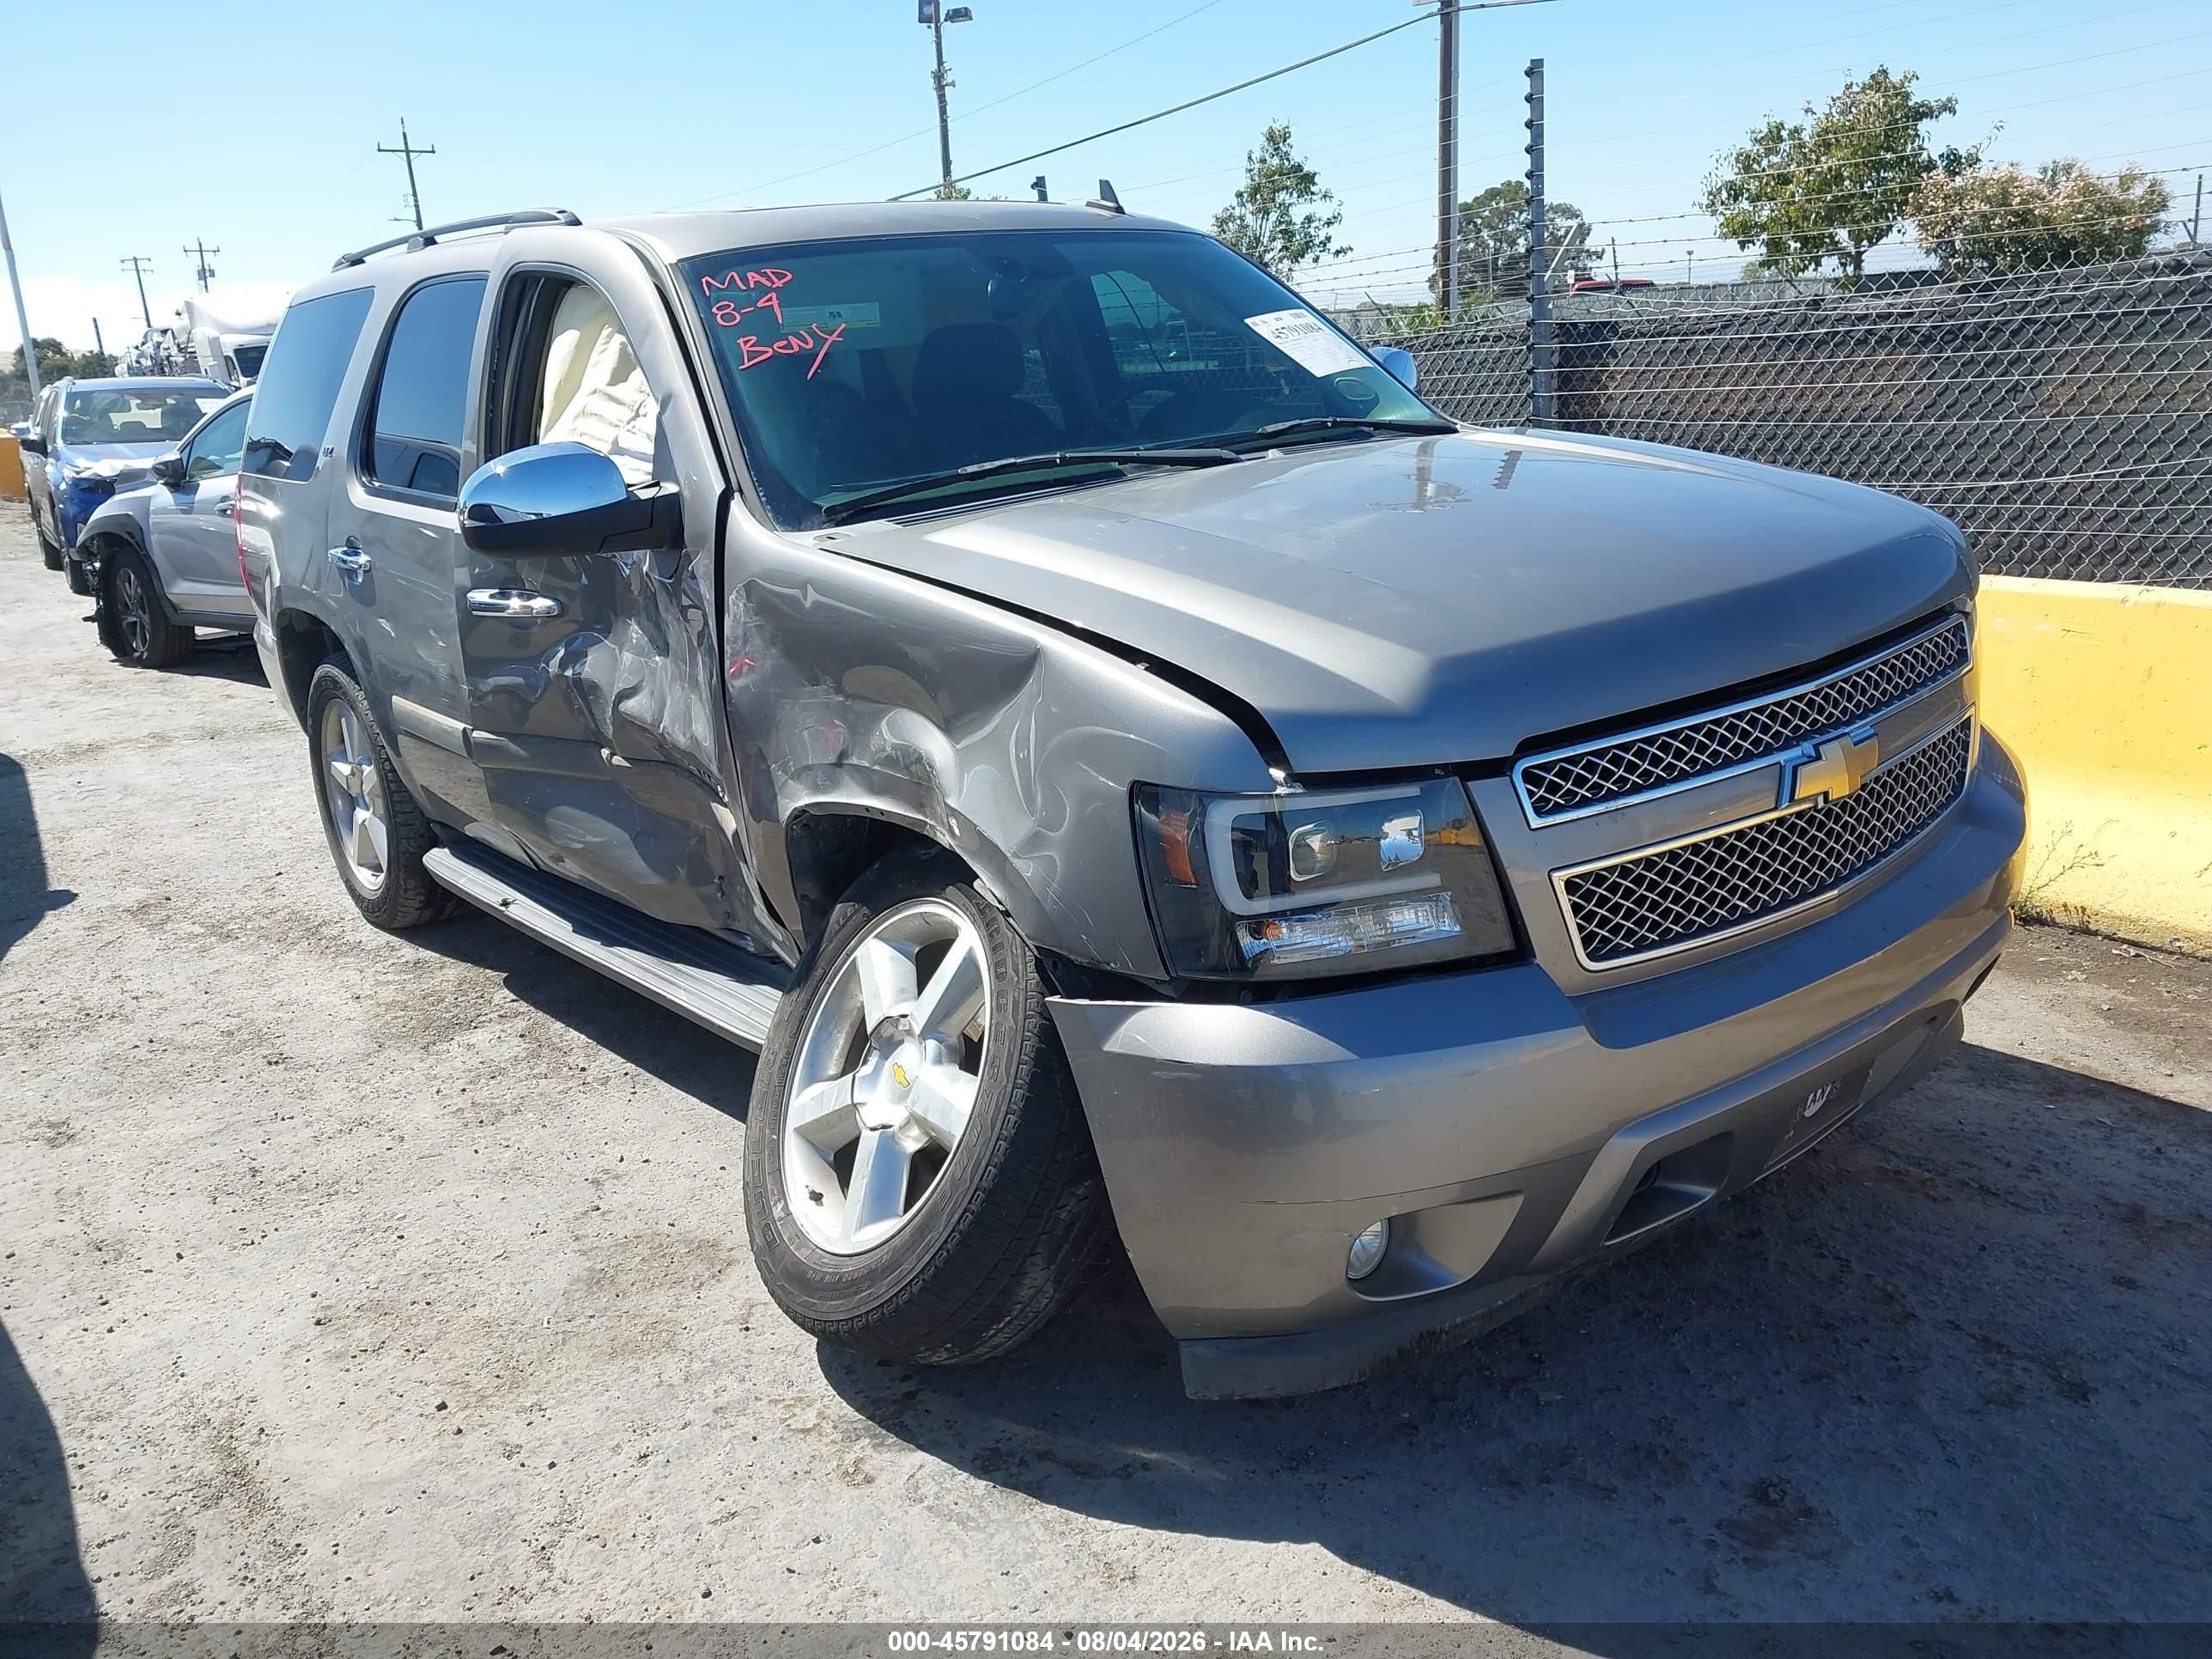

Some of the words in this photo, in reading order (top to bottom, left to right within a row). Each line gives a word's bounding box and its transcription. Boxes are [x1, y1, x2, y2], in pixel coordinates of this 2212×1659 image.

[701, 268, 793, 297] MAD
[1270, 322, 1325, 340] 45791084
[937, 896, 1009, 1213] BRIDGESTONE
[748, 1049, 780, 1251] DUELER
